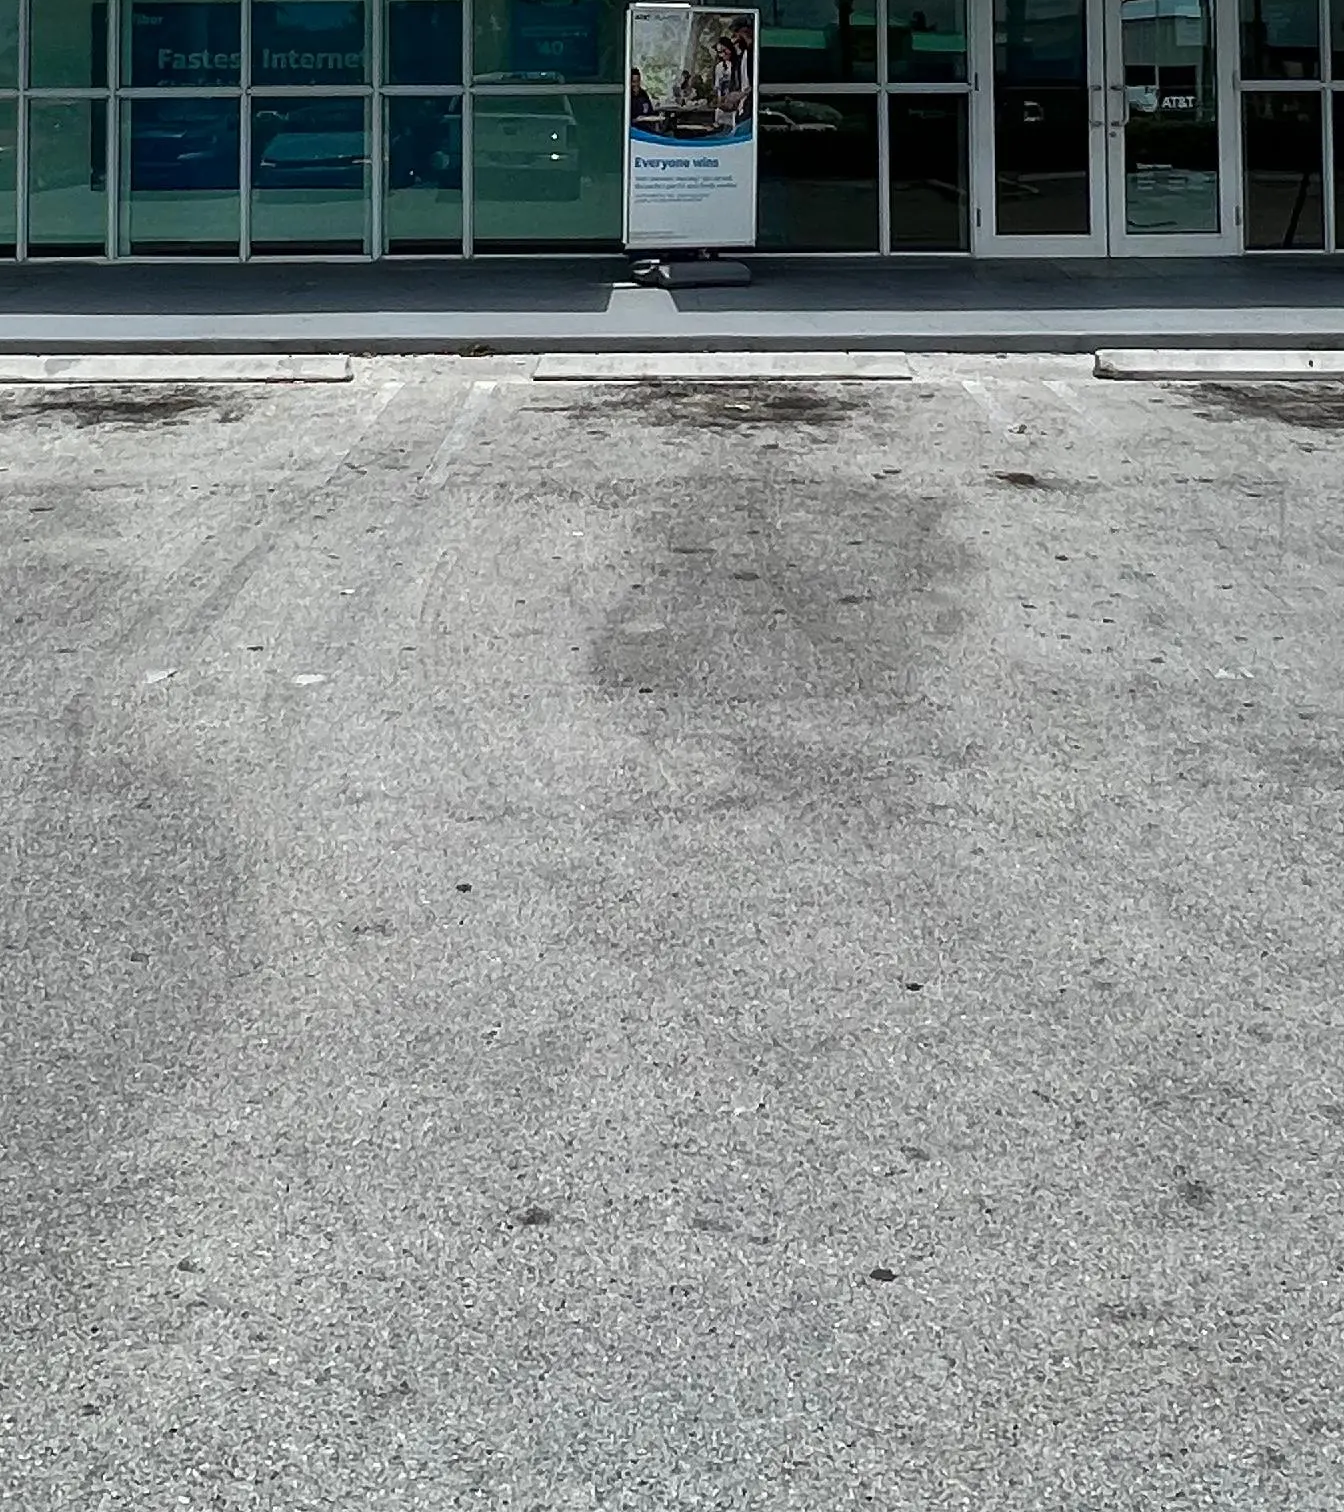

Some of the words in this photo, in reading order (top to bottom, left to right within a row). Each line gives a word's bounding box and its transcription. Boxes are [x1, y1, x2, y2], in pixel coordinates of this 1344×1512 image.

[158, 48, 242, 70] Fastes
[1161, 95, 1196, 108] AT&T
[634, 157, 690, 170] Everyone
